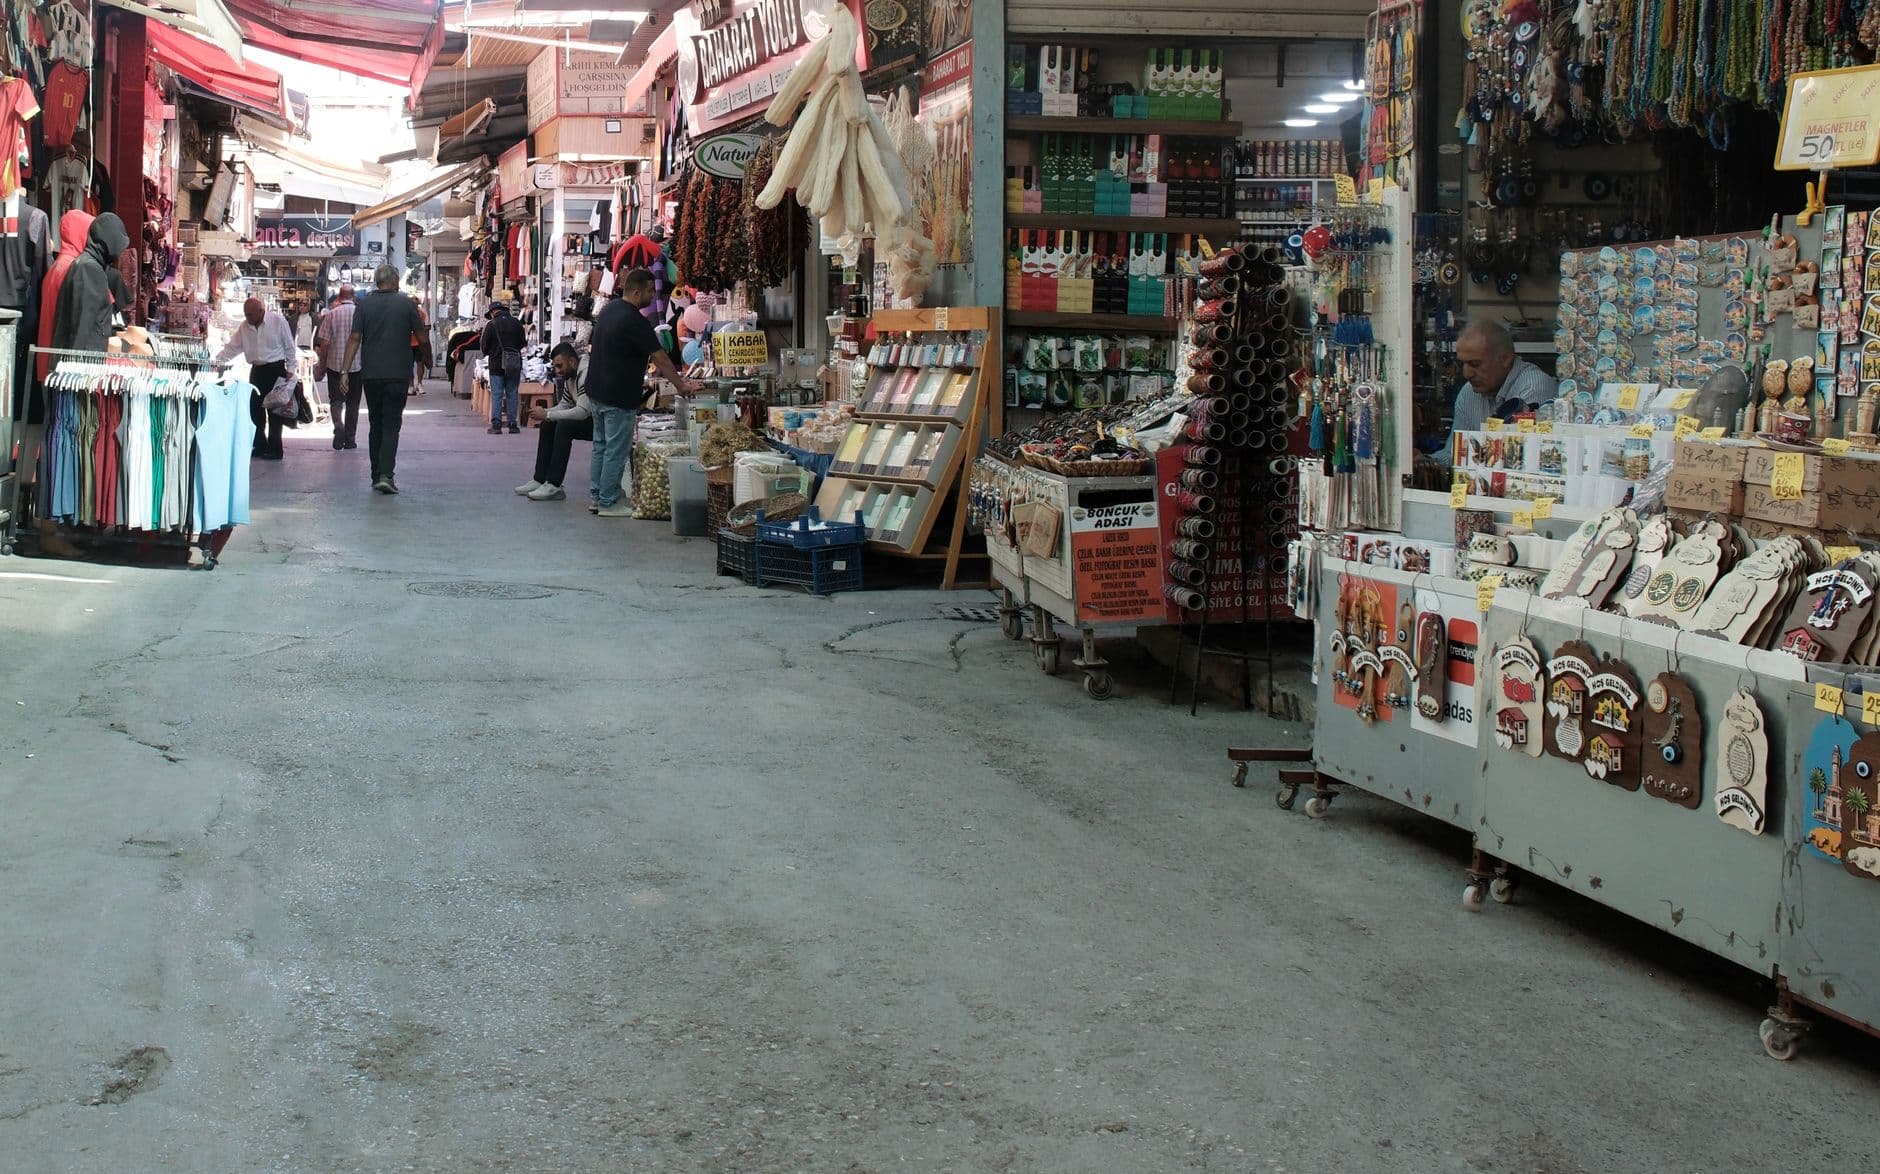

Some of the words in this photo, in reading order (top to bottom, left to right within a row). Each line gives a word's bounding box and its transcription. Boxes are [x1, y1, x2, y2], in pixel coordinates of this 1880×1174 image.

[698, 8, 758, 89] BAHARAT
[757, 0, 798, 58] YOLU
[956, 47, 970, 71] YOLU
[63, 92, 74, 109] 10
[1806, 120, 1867, 135] MAGNETLER
[1799, 135, 1834, 160] 50
[255, 224, 301, 248] anta
[728, 335, 765, 347] KABAK
[1087, 505, 1141, 518] BONCUK
[1094, 517, 1133, 529] ADASI
[1553, 660, 1566, 672] HOŞ
[1591, 677, 1605, 689] HOŞ
[1605, 677, 1633, 701] GELDİNİZ
